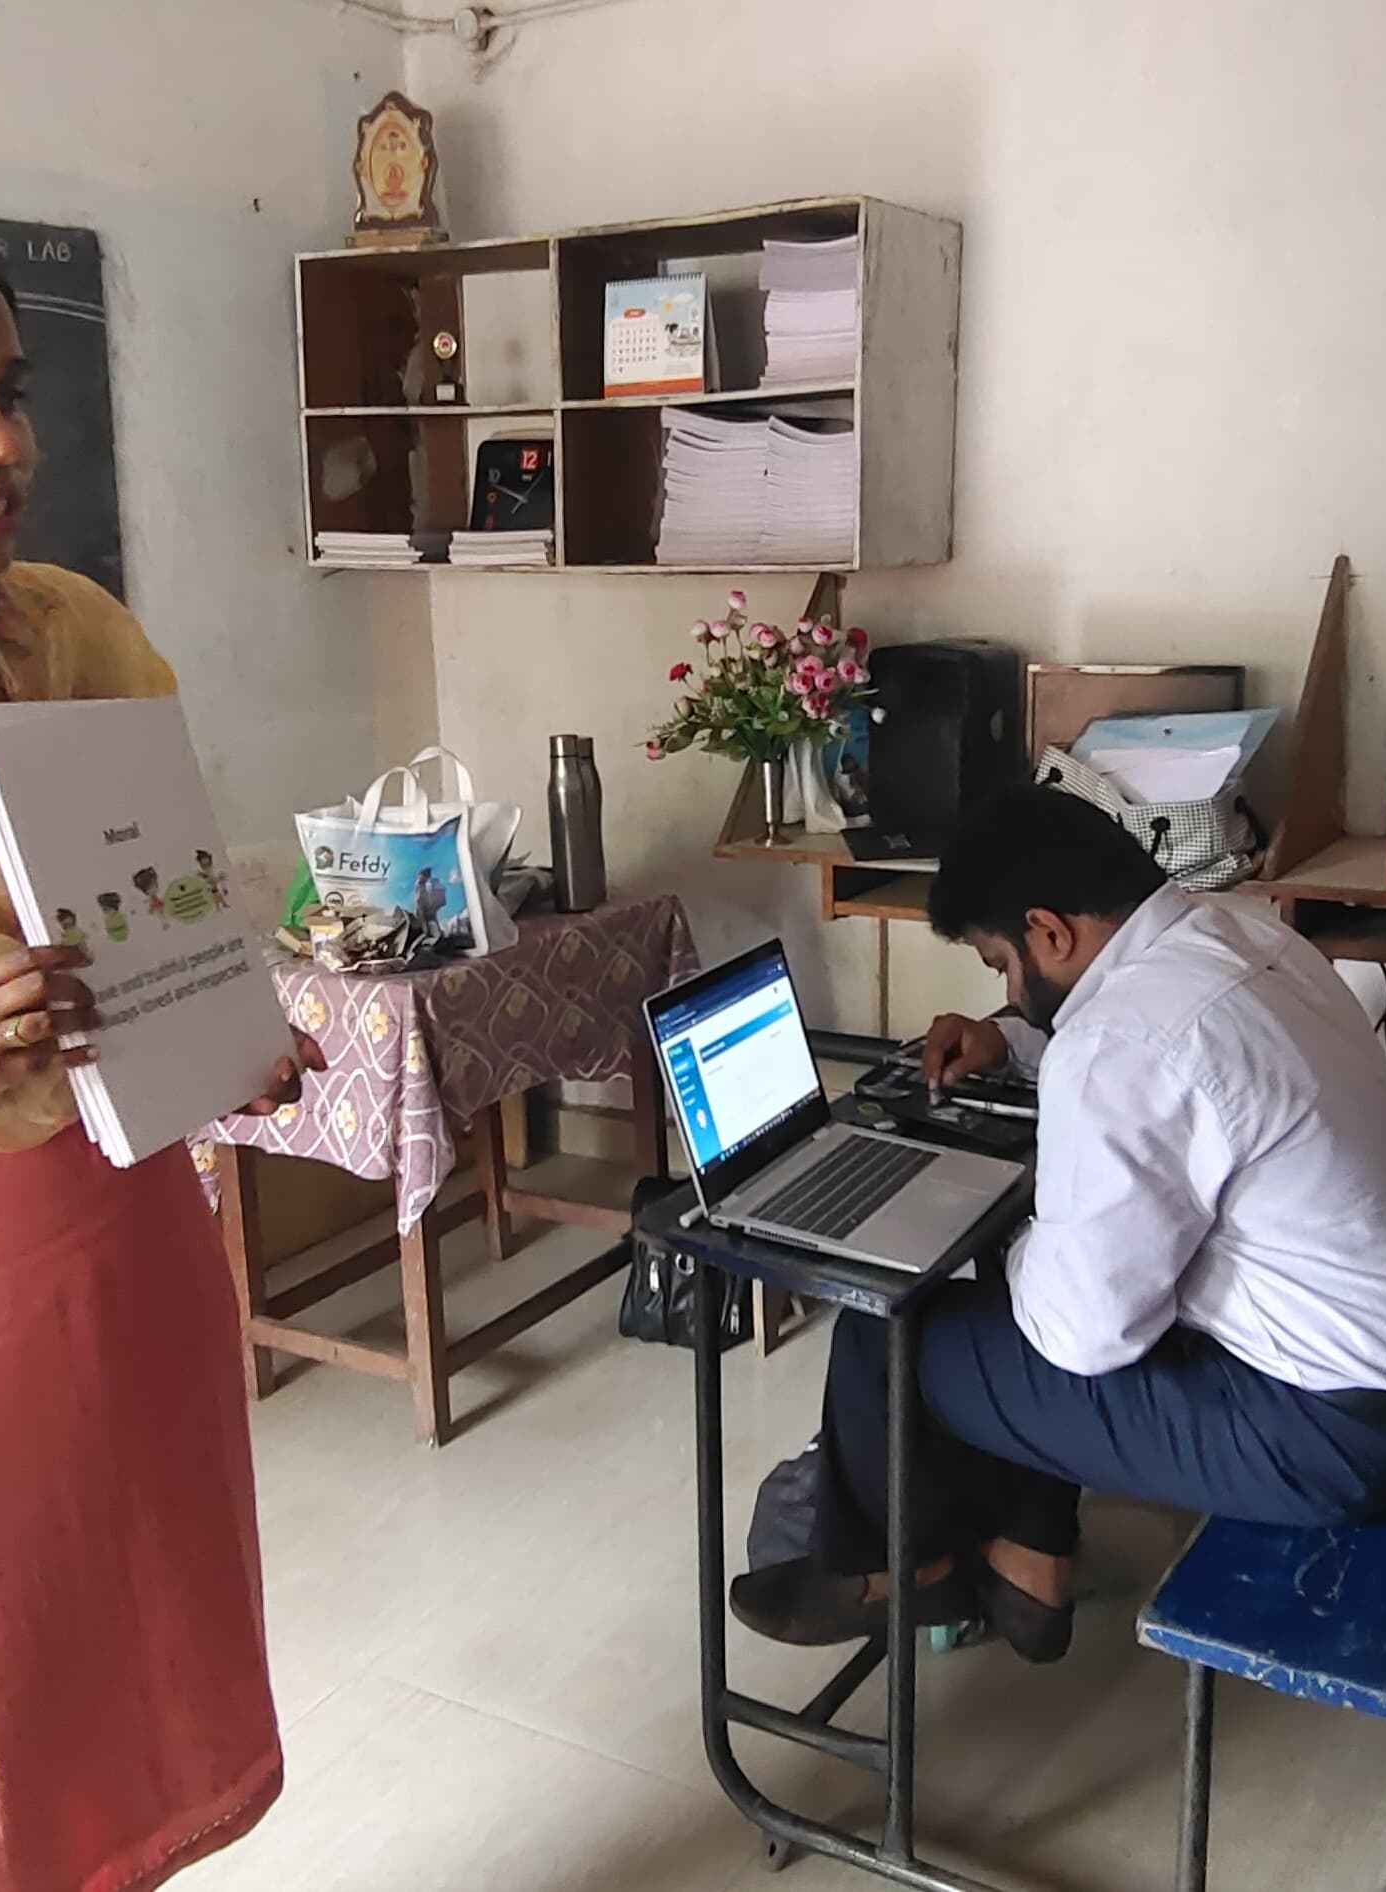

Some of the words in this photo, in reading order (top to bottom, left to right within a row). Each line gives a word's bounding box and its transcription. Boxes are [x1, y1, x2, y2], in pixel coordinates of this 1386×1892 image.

[27, 240, 71, 262] LAB
[521, 449, 538, 470] 12
[339, 851, 391, 877] Fefdy
